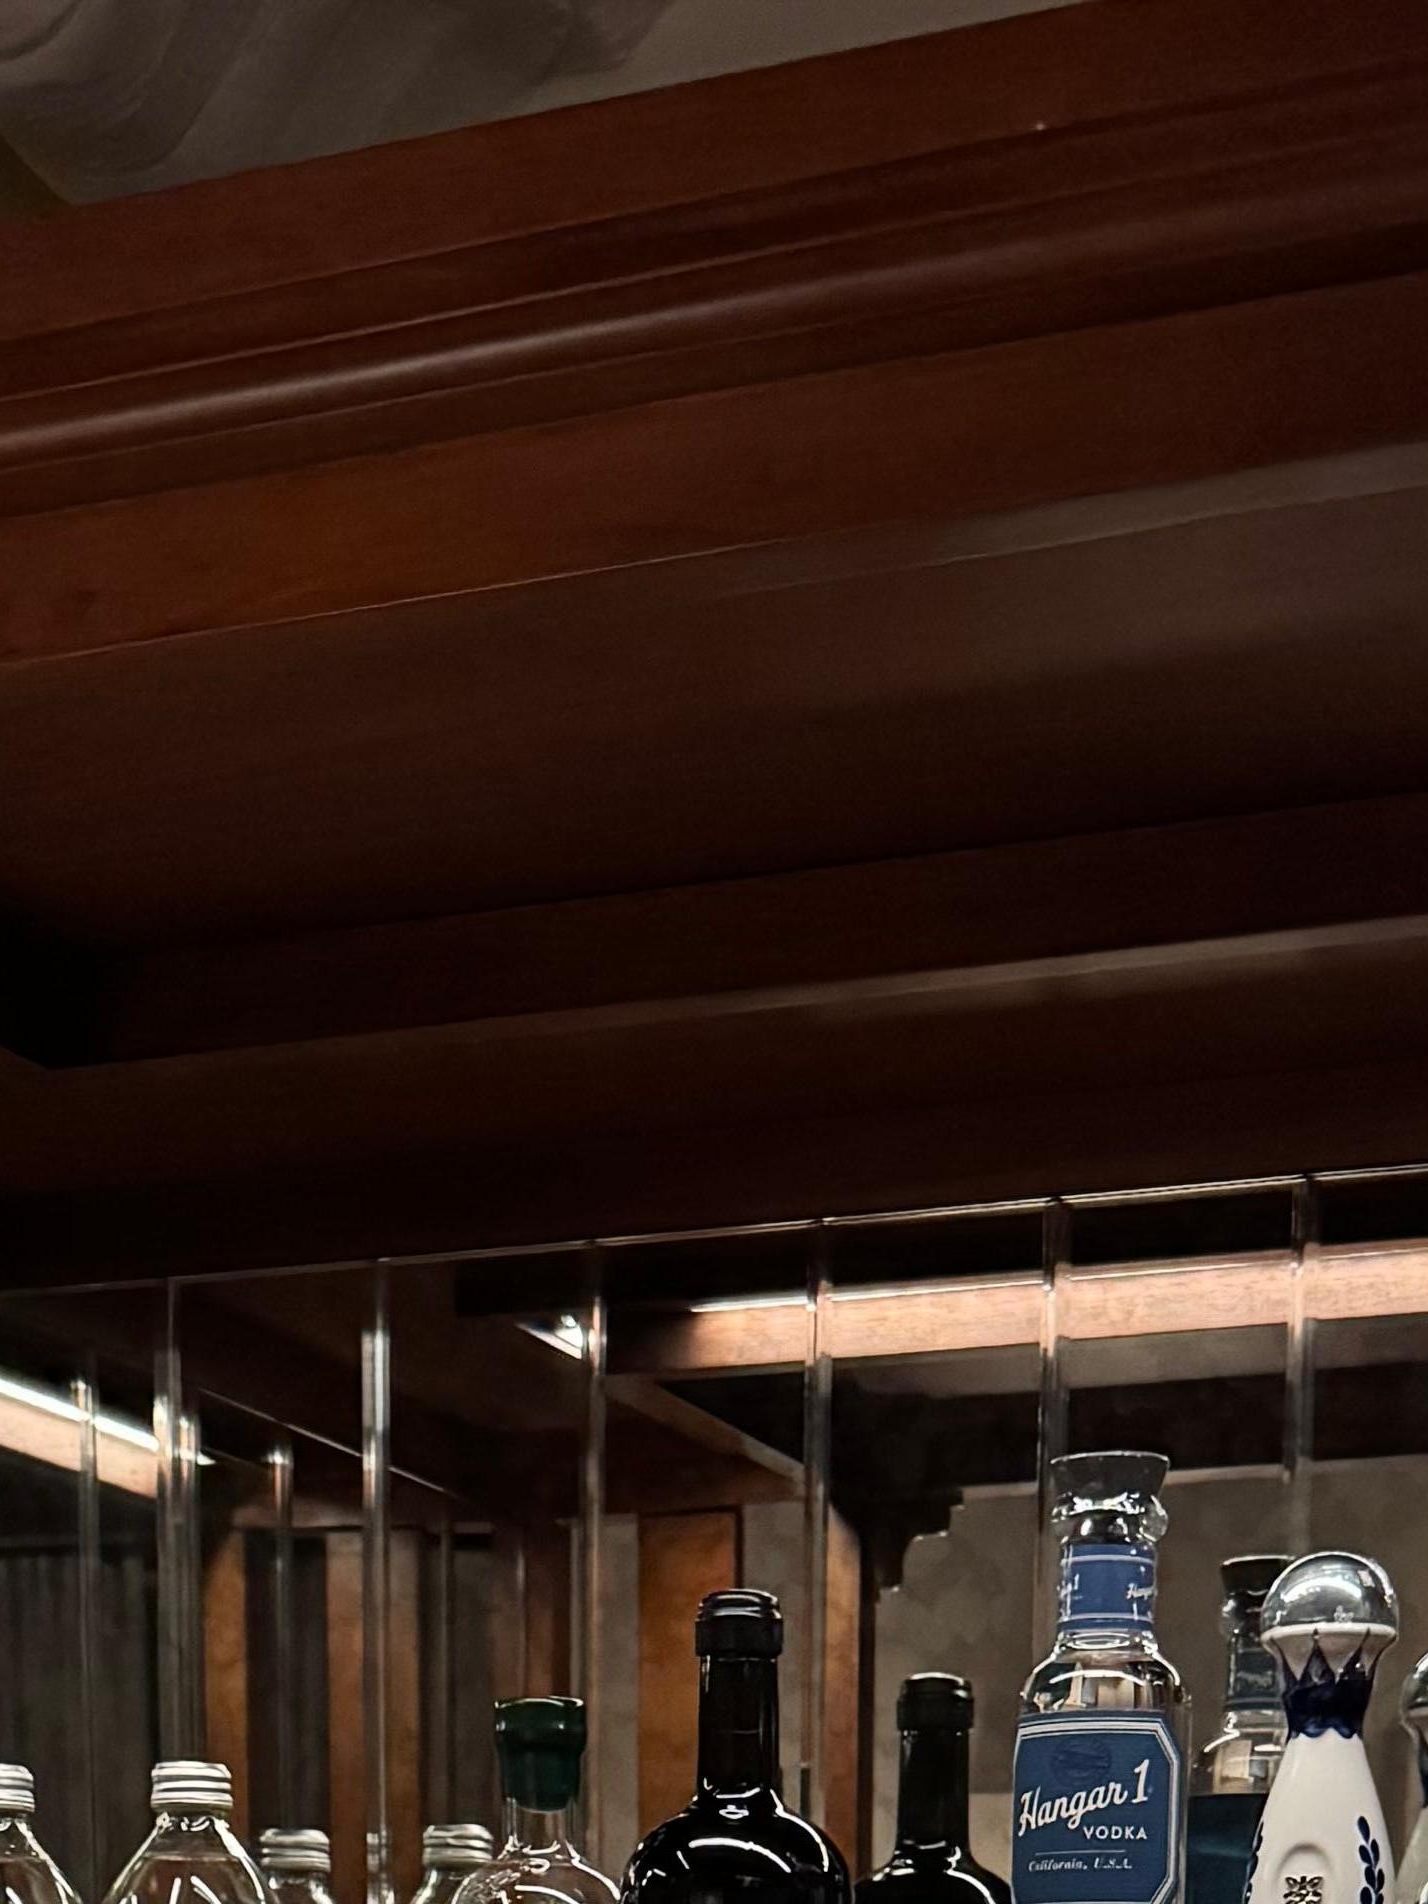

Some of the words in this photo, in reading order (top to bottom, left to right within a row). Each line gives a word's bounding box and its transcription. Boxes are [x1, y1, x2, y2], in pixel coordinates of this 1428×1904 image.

[1018, 1781, 1129, 1838] Hangar
[1131, 1758, 1150, 1804] 1
[1082, 1825, 1148, 1841] VODKA
[1028, 1859, 1089, 1873] California,
